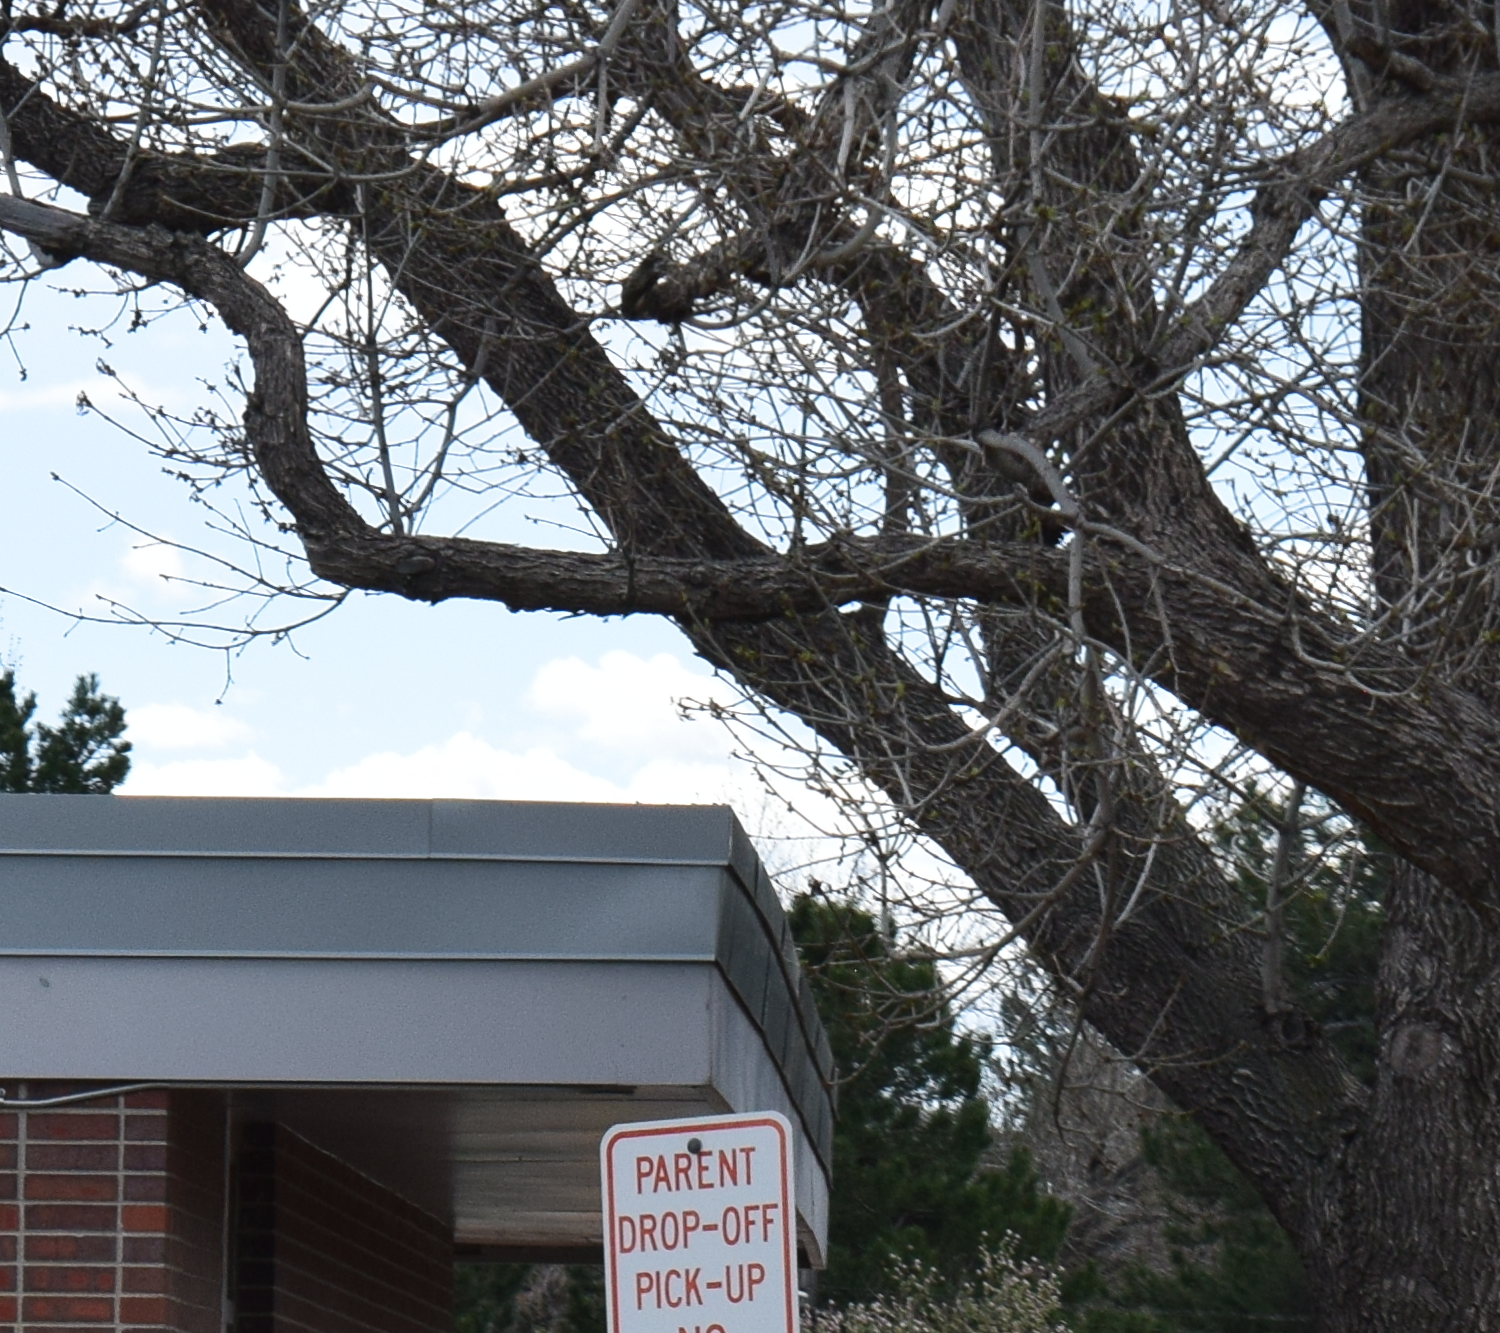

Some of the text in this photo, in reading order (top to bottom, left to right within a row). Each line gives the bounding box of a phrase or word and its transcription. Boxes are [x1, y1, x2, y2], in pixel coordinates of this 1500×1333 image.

[635, 1146, 757, 1195] PARENT
[618, 1202, 779, 1254] DROP-OFF
[635, 1264, 765, 1310] PICK-UP
